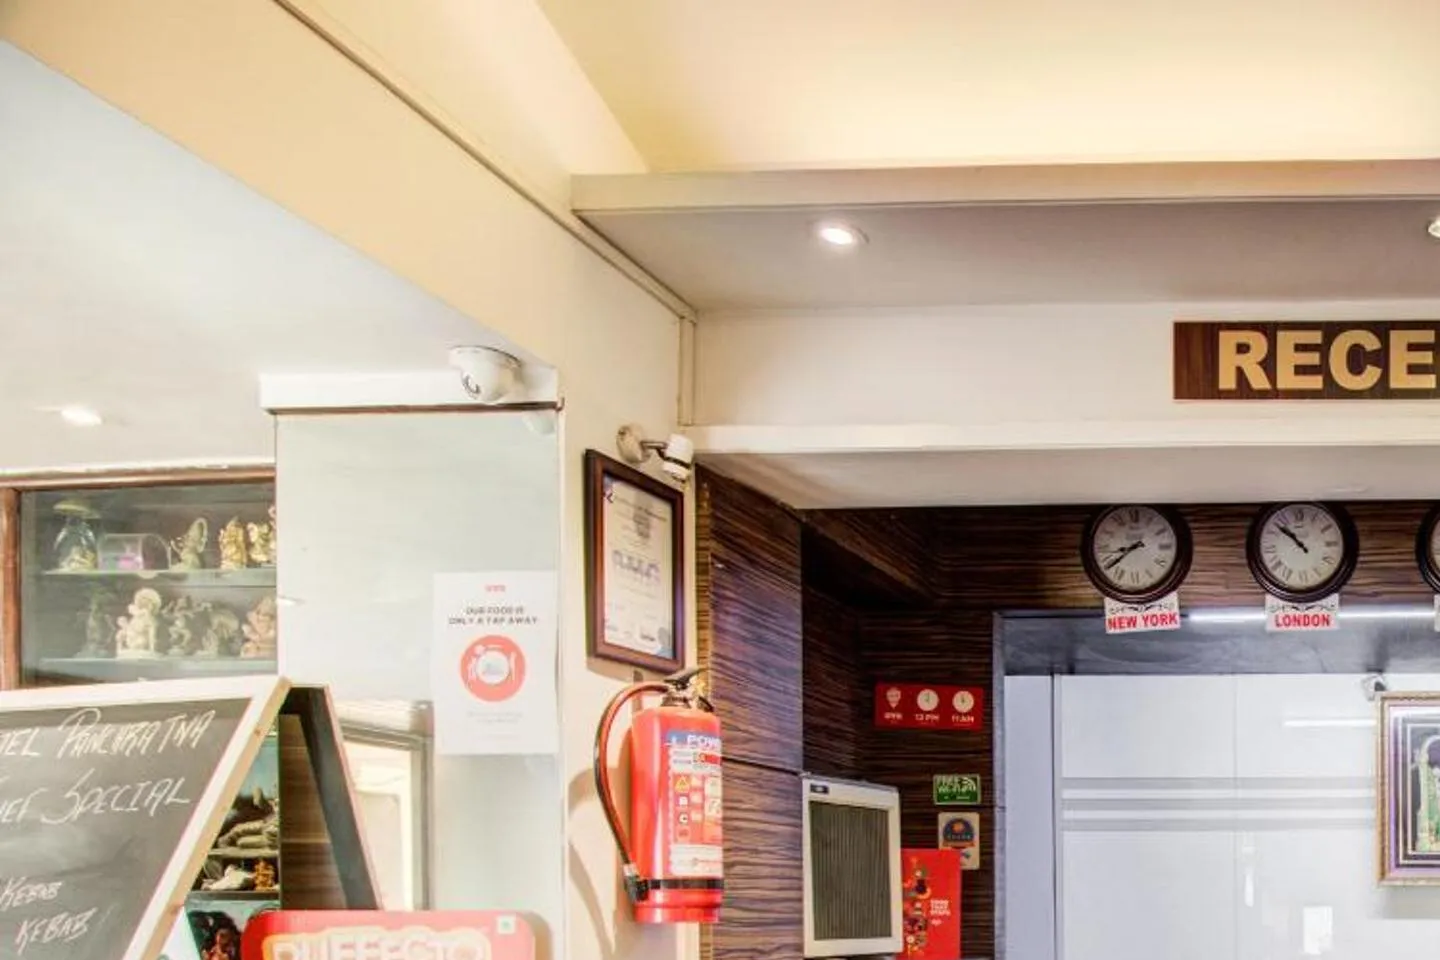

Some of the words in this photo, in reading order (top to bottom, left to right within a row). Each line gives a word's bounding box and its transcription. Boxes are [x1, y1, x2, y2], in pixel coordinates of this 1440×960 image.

[1107, 614, 1138, 630] NEW
[1142, 612, 1178, 627] YORK
[1275, 613, 1331, 628] LONDON
